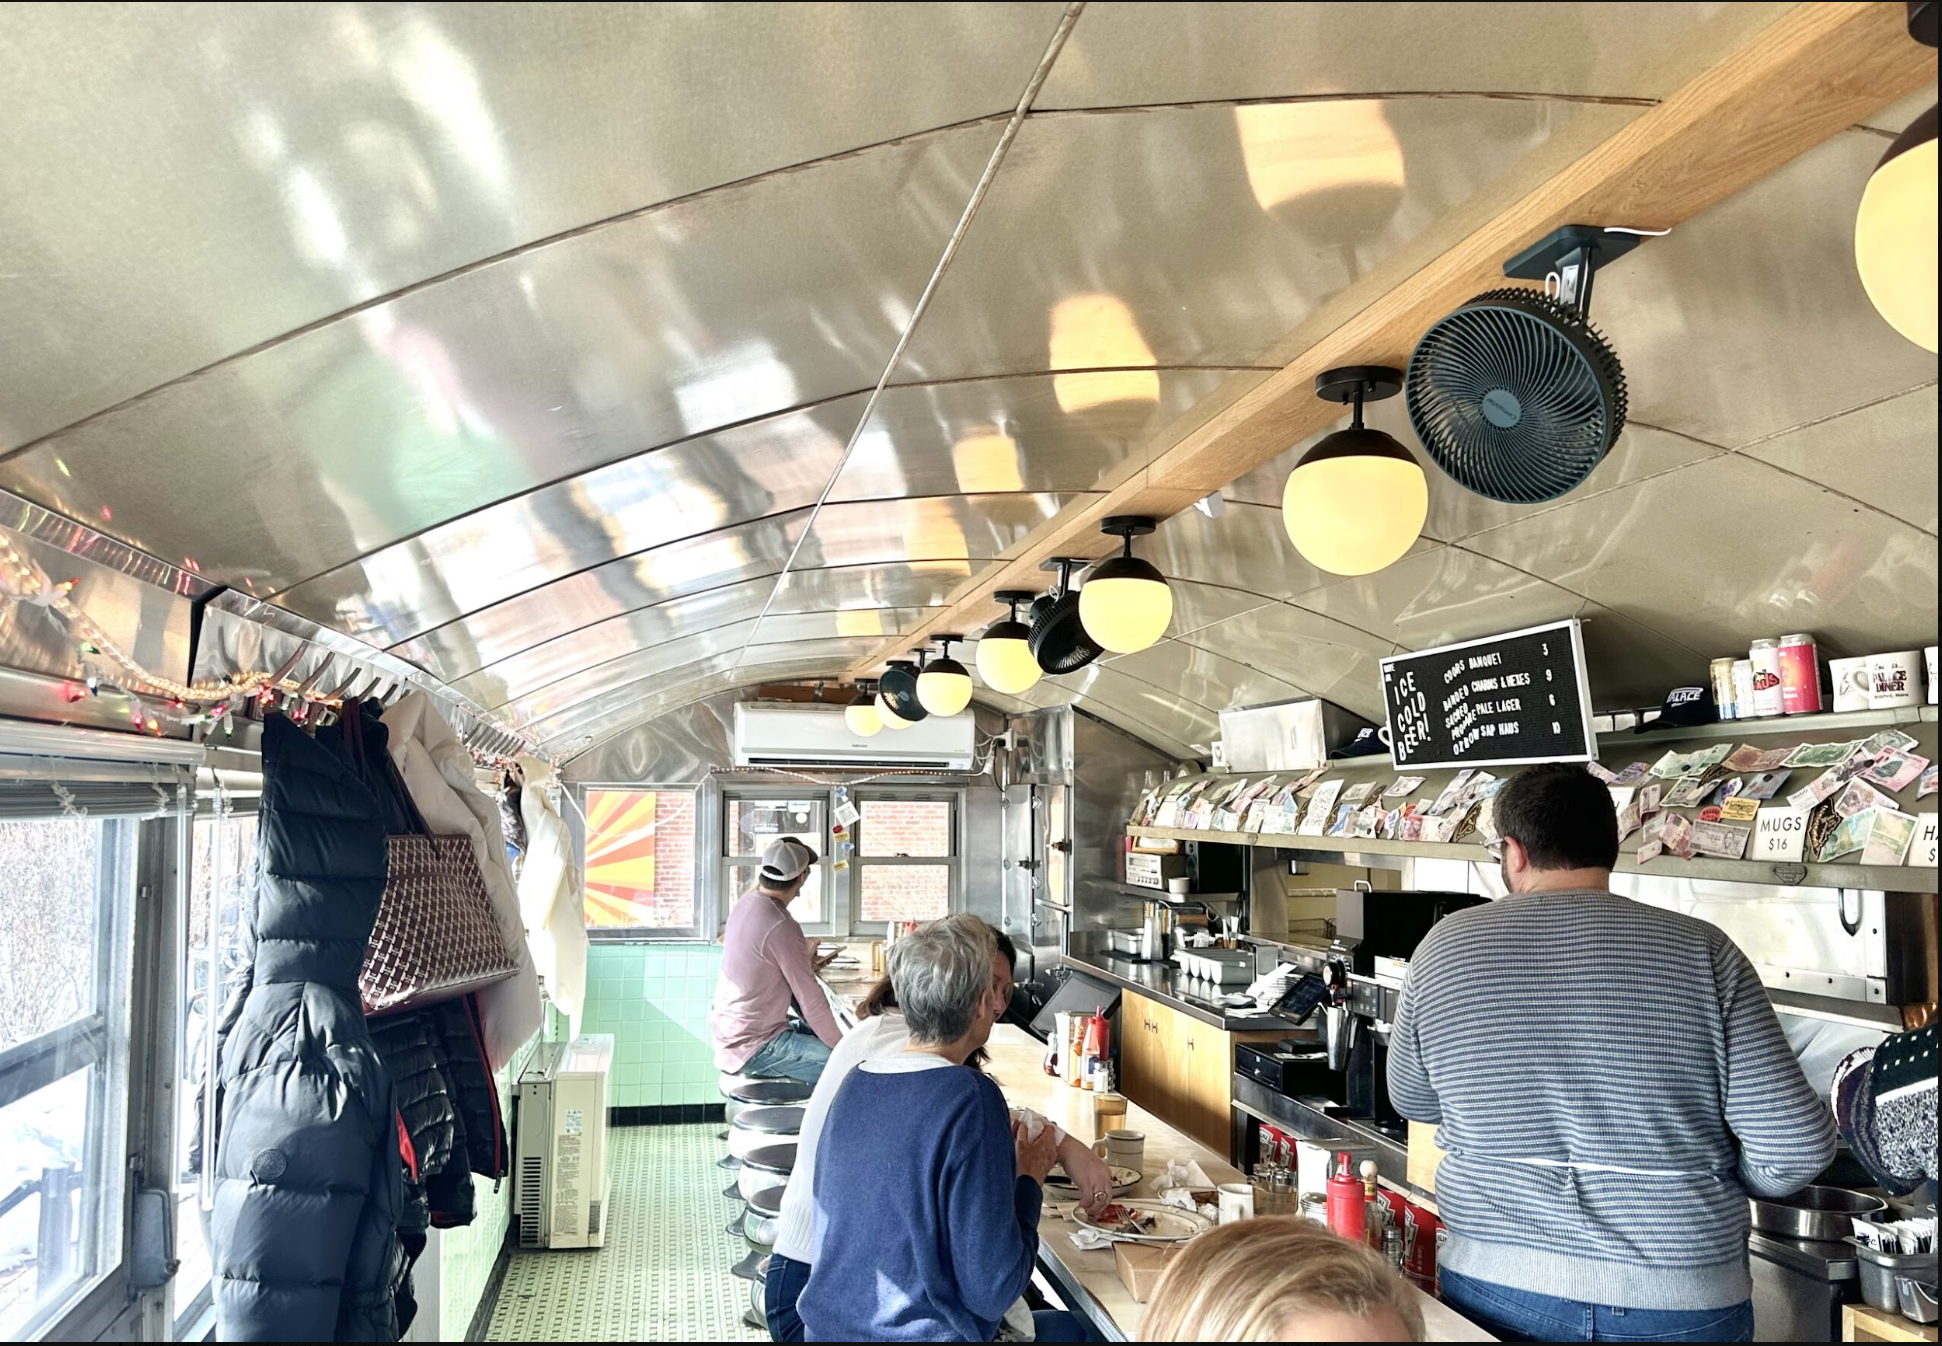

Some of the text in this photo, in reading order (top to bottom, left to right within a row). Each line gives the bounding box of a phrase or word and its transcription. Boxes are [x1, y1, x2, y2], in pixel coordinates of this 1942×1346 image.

[1443, 642, 1549, 684] COORS BANQUET 3
[1545, 668, 1553, 682] 9
[1393, 671, 1417, 706] ICE
[1876, 681, 1905, 693] DINER
[1397, 691, 1426, 733] COLD
[1445, 702, 1469, 729] SACRED
[1475, 701, 1495, 715] PALE
[1496, 698, 1522, 713] LAGER
[1548, 693, 1556, 707] 6
[1397, 713, 1432, 761] BEER!
[1453, 728, 1480, 756] OXBOW
[1480, 723, 1496, 737] SAP
[1498, 721, 1520, 736] HAUS
[1760, 817, 1802, 832] MUGS
[1768, 838, 1788, 851] $16
